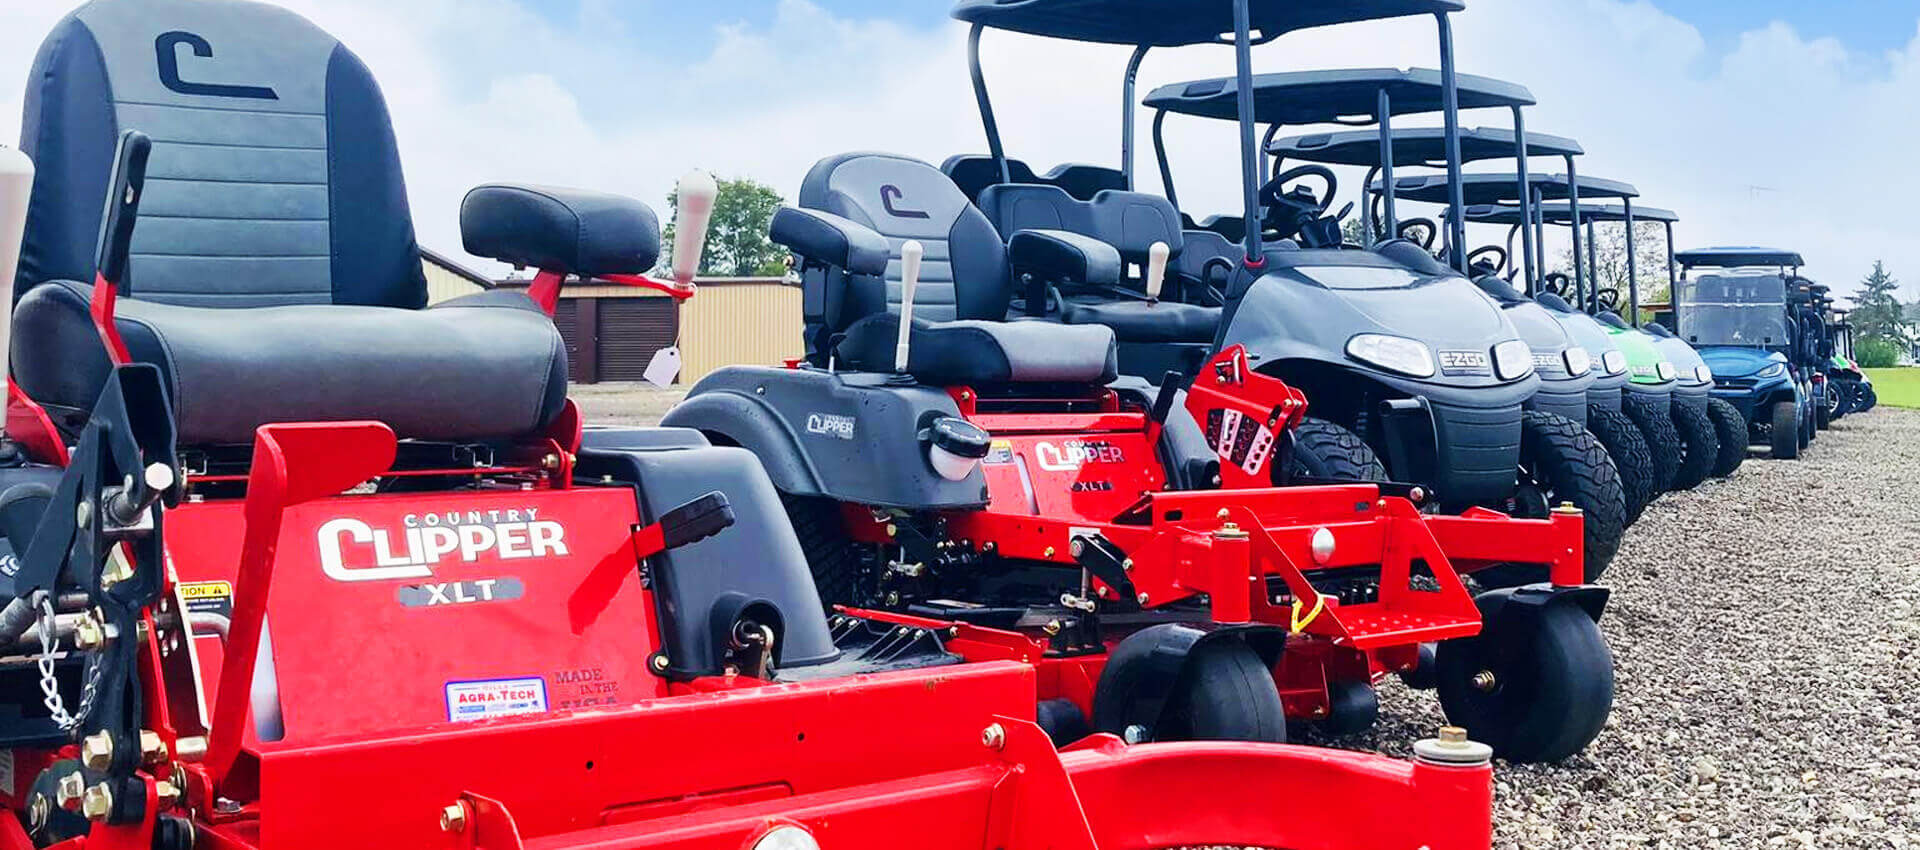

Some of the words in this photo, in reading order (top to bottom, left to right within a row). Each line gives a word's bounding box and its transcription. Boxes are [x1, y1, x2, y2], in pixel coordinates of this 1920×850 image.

[807, 414, 854, 434] CLIPPER
[1035, 441, 1125, 471] CLIPPER
[1080, 480, 1104, 491] XLT
[404, 508, 538, 527] COUNTRY
[318, 518, 569, 581] CLIPPER
[425, 579, 496, 606] XLT
[555, 668, 602, 684] MADE
[459, 690, 535, 703] AGRA-TECH
